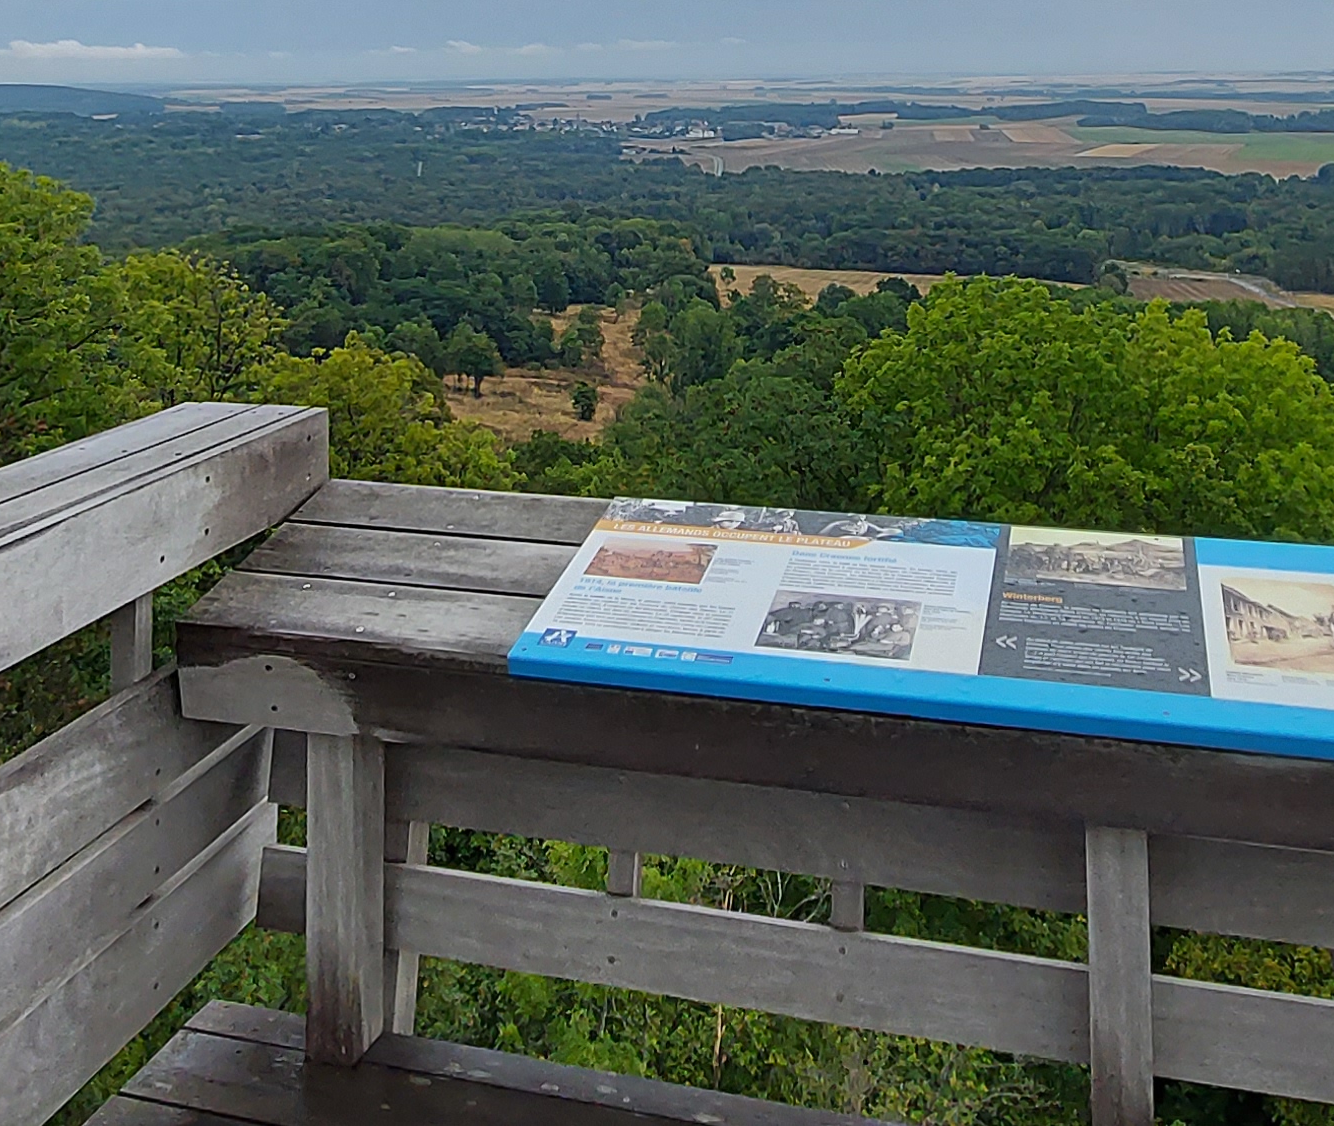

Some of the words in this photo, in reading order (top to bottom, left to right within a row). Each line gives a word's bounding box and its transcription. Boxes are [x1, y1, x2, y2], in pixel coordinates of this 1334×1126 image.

[613, 523, 634, 532] LES
[637, 524, 709, 537] ALLEMANDS
[713, 530, 774, 542] OCCUPENT
[778, 535, 794, 544] LE
[797, 536, 851, 547] PLATEAU
[1002, 591, 1063, 604] Winterberg
